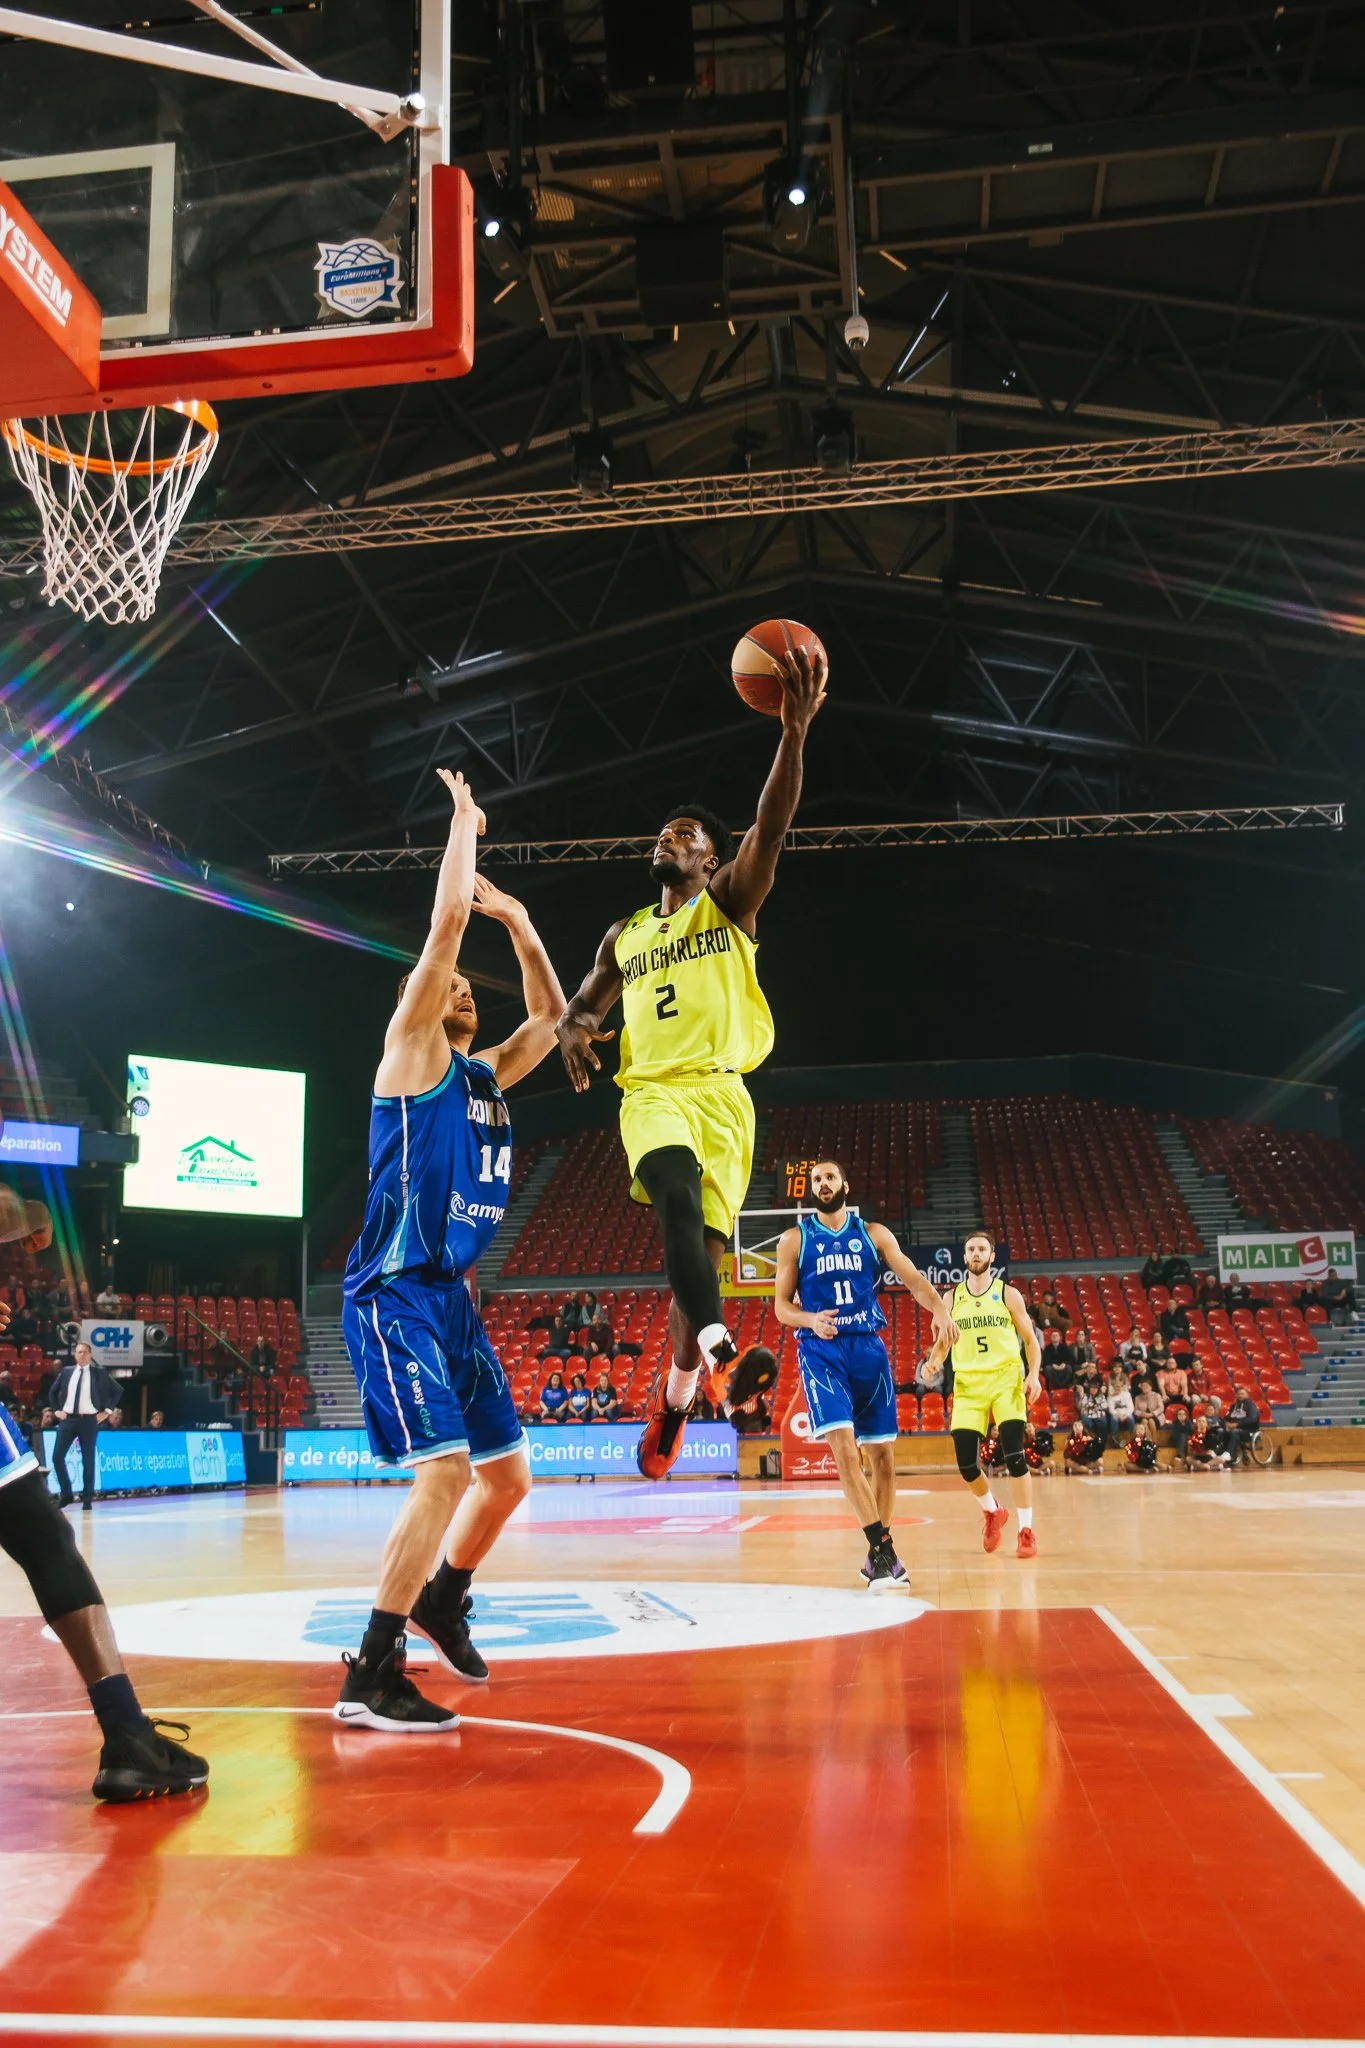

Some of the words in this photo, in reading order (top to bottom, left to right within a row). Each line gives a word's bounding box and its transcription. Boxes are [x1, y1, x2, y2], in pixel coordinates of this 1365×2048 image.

[330, 269, 380, 283] EuroMillions
[340, 286, 378, 297] BASKETBALL
[650, 926, 731, 971] CHARLEROI
[655, 983, 679, 1021] 2
[479, 1144, 511, 1185] 14
[787, 1177, 806, 1198] 18
[816, 1254, 862, 1276] DONAR
[1225, 1242, 1346, 1266] MATCH
[833, 1280, 854, 1306] 11
[976, 1336, 988, 1353] 5
[300, 1446, 324, 1466] de
[531, 1443, 595, 1462] Centre
[600, 1440, 624, 1460] de
[100, 1452, 129, 1473] Centre
[131, 1452, 143, 1472] de
[144, 1451, 188, 1475] réparation
